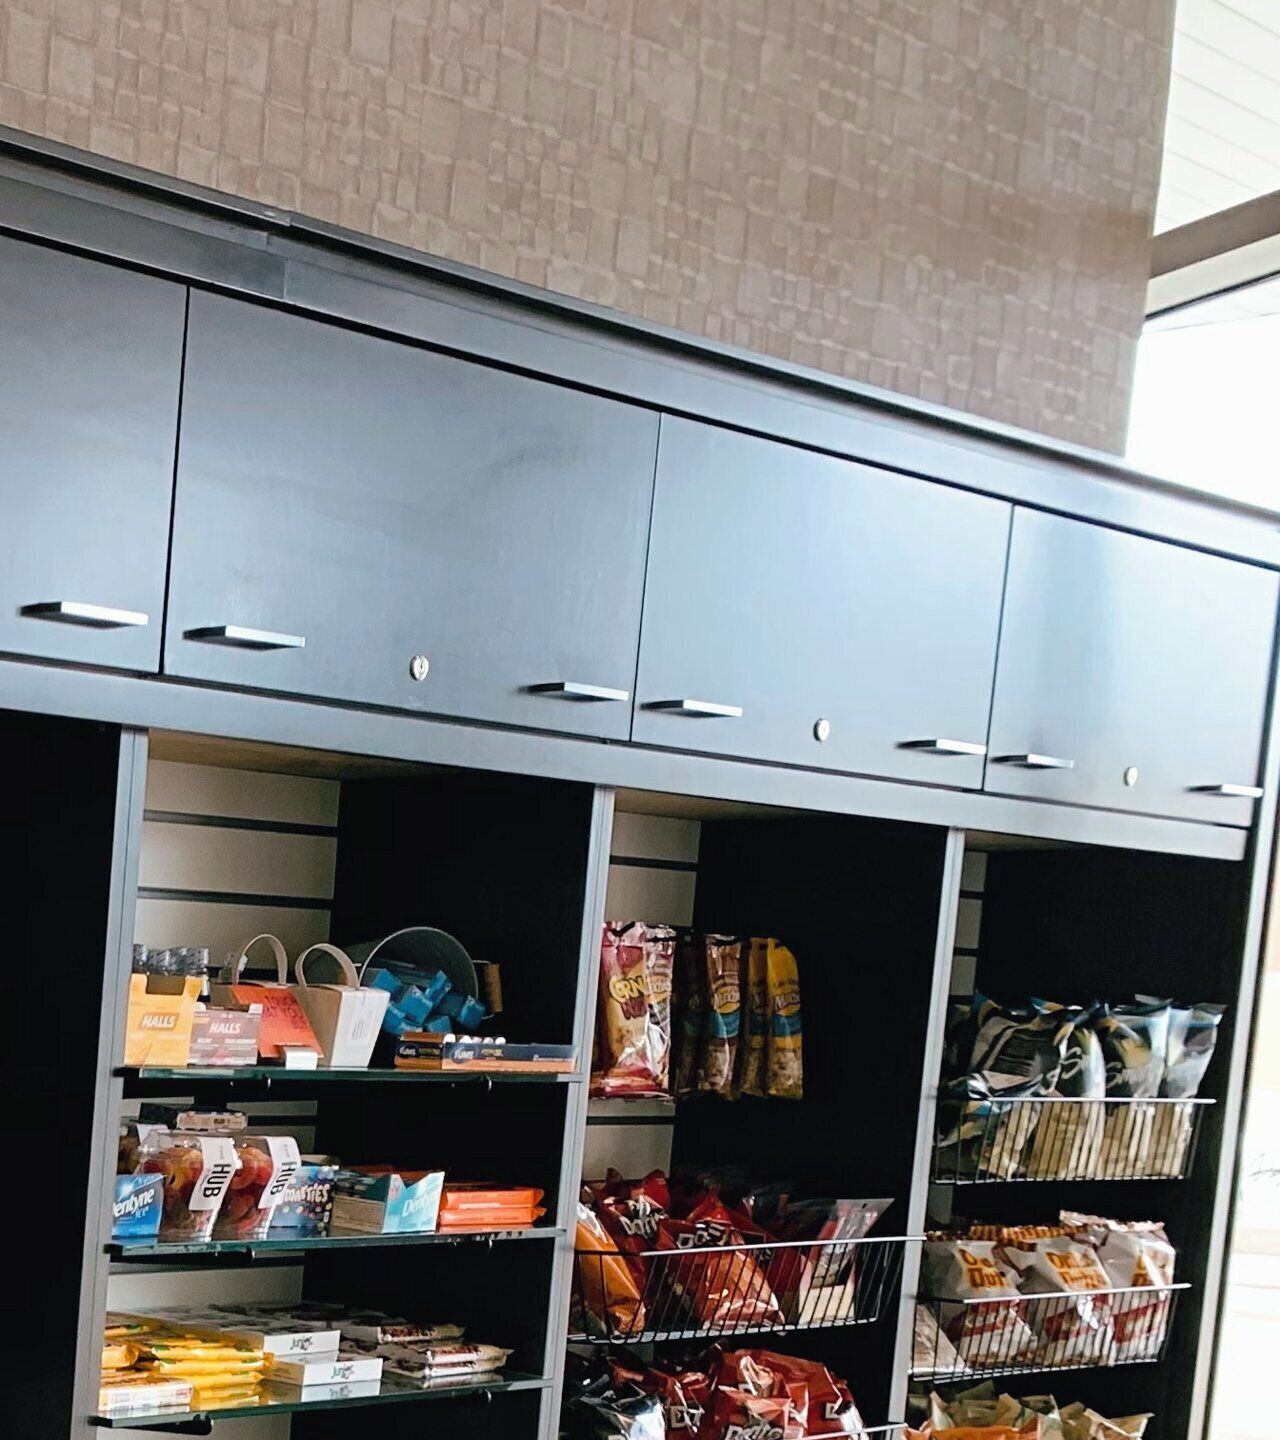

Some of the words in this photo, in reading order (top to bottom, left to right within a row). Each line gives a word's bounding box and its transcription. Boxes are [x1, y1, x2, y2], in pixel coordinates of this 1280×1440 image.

[142, 1015, 176, 1028] HALLS
[210, 1023, 241, 1034] HALLS
[203, 1163, 232, 1198] HUB
[270, 1161, 297, 1196] HUB
